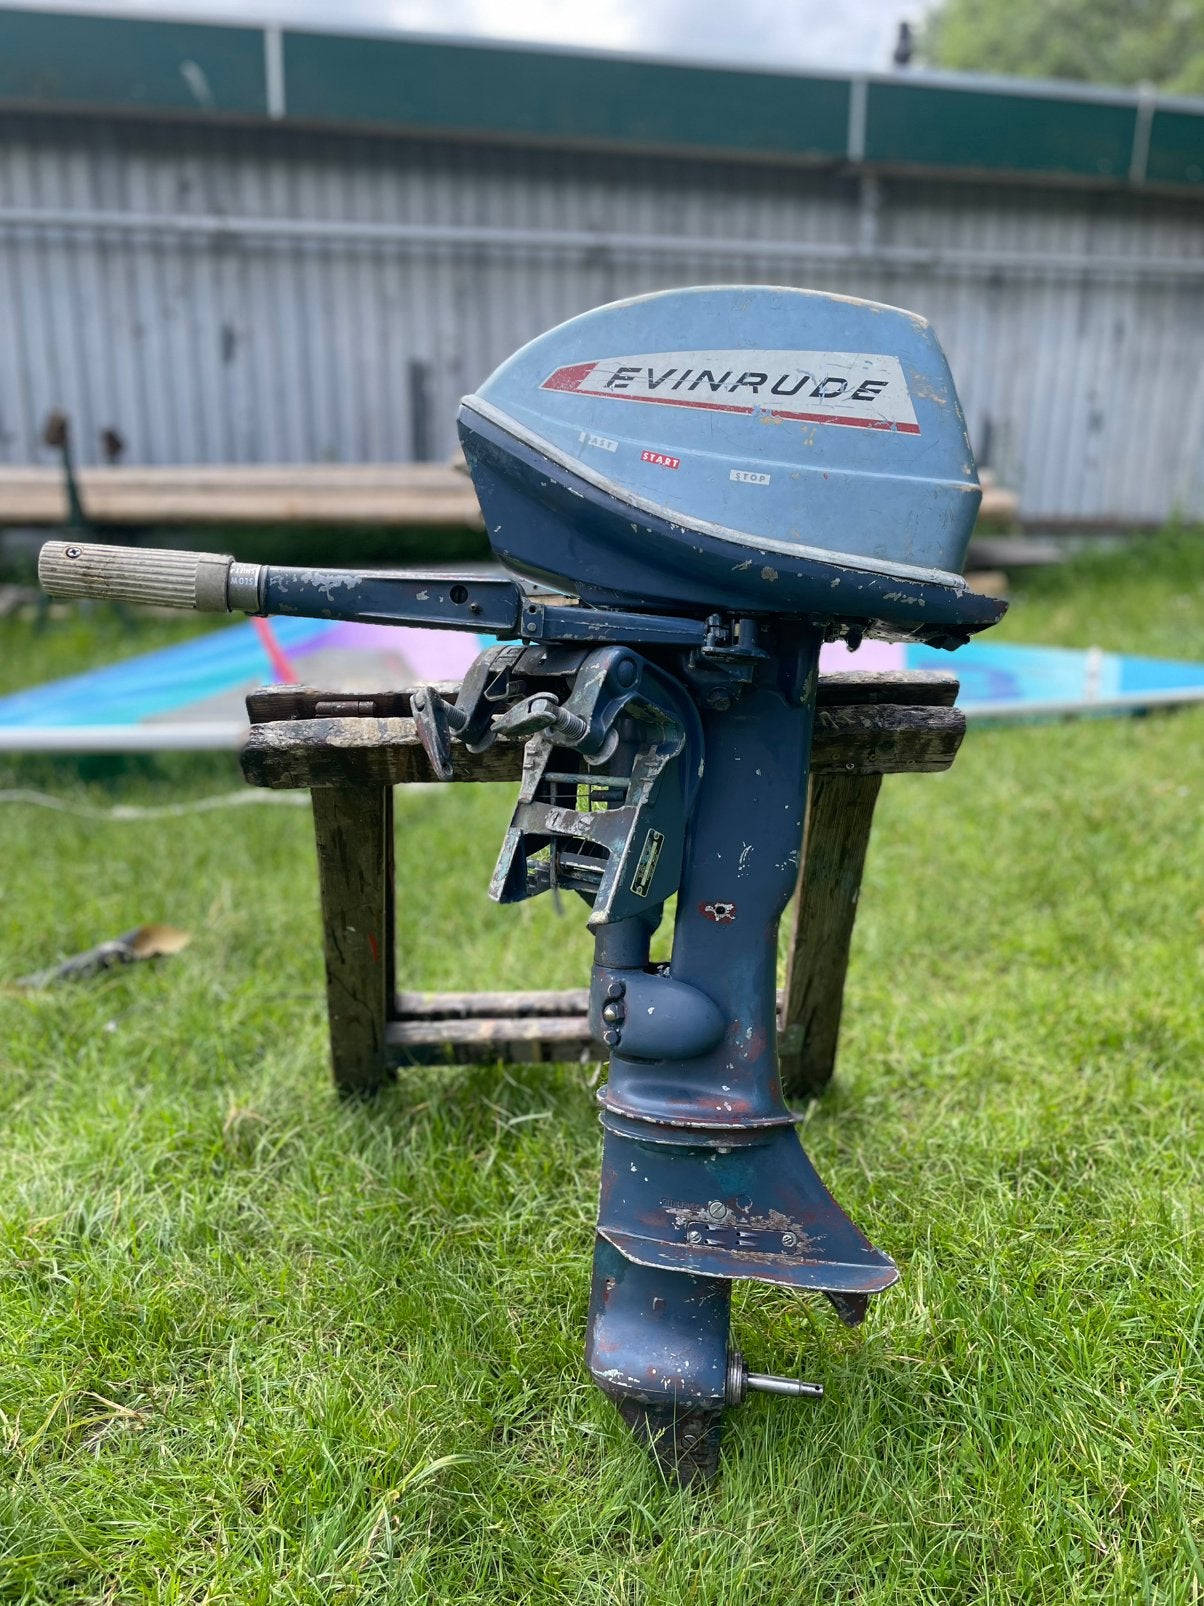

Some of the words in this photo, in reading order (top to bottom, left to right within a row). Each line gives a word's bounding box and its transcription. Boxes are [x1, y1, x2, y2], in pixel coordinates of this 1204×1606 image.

[604, 367, 889, 401] EVINRUDE
[642, 452, 679, 468] START
[735, 472, 766, 482] STOP
[230, 576, 254, 586] SLOW
